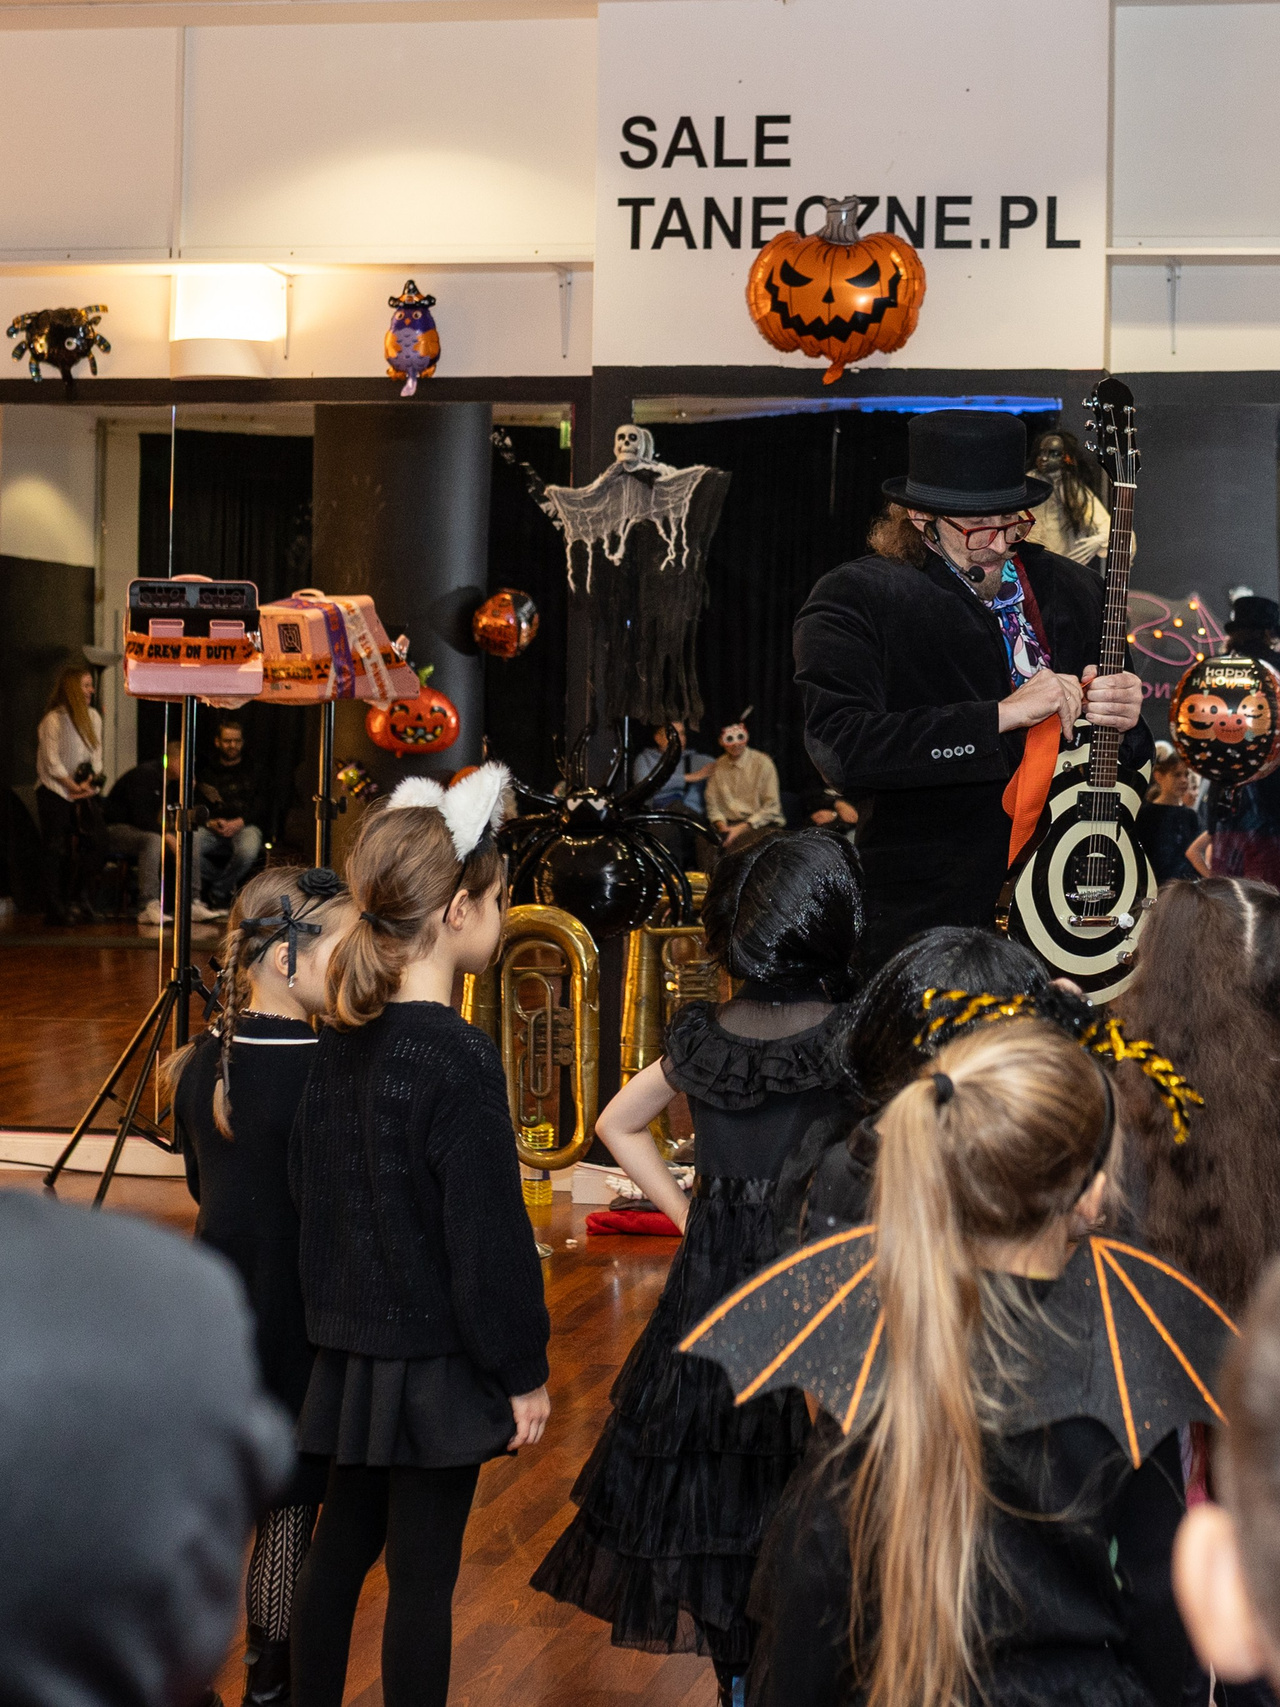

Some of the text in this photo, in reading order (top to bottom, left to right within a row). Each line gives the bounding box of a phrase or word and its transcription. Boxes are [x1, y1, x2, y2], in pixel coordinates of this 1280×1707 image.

[619, 114, 791, 169] SALE
[147, 643, 181, 659] CREW
[186, 644, 201, 658] ON
[206, 645, 236, 660] DUTY
